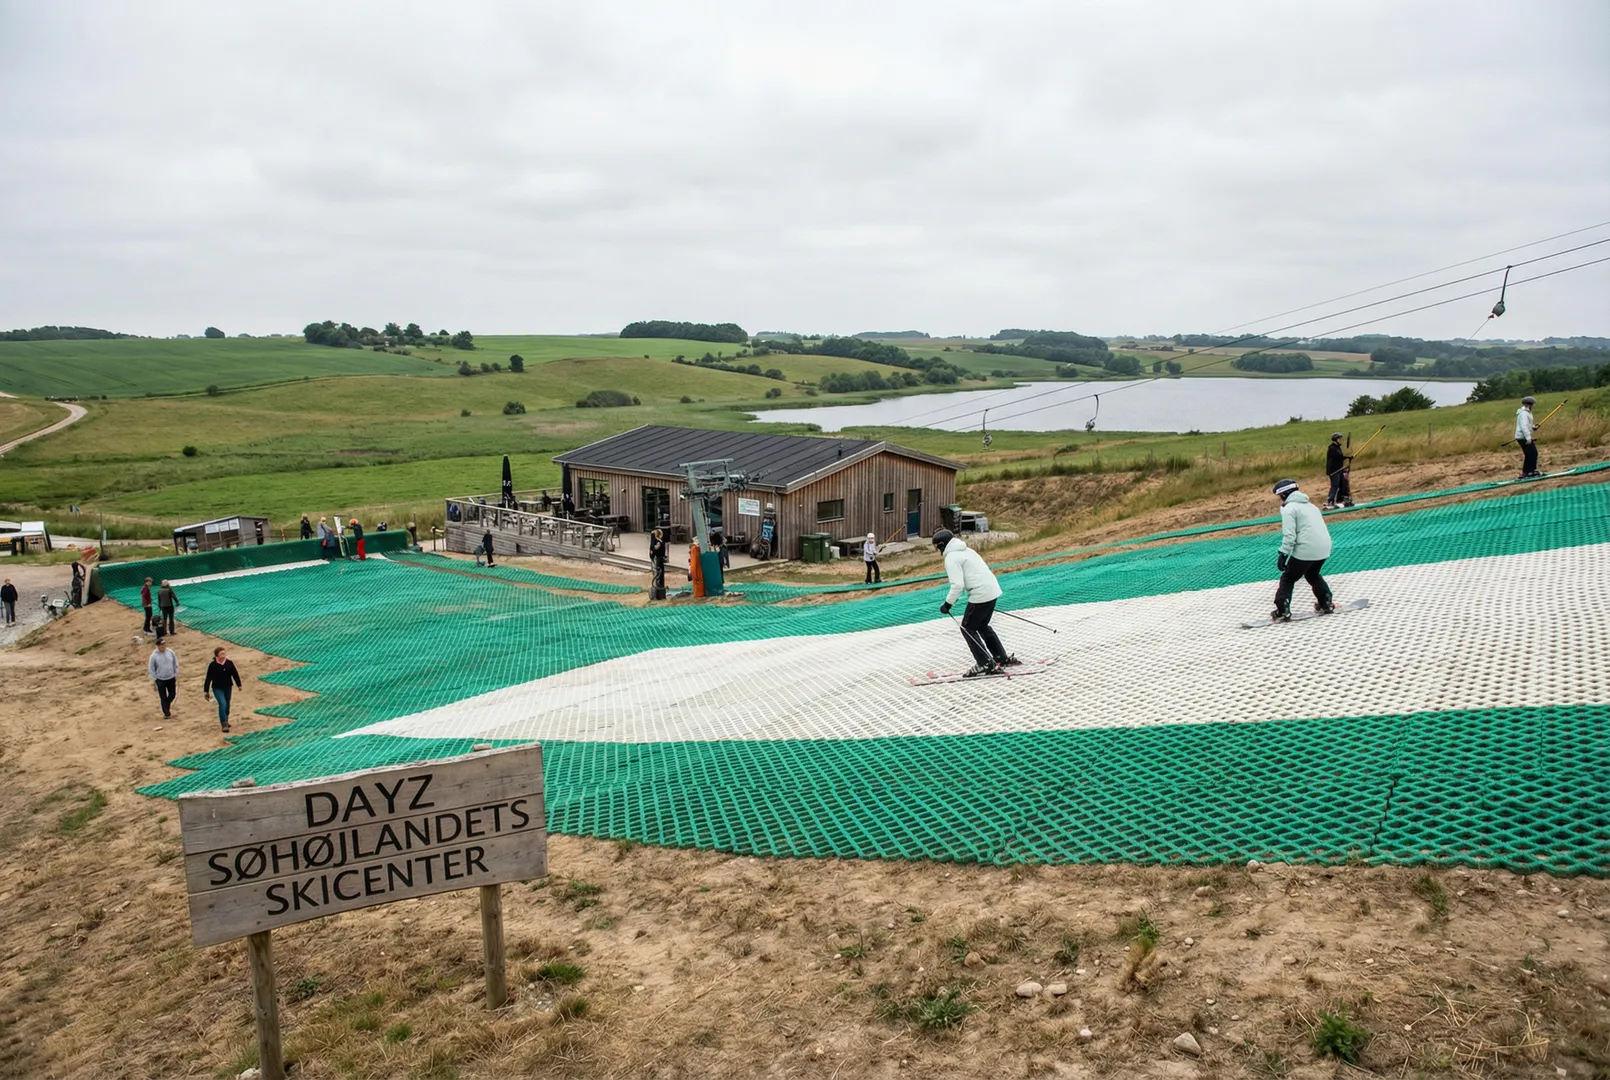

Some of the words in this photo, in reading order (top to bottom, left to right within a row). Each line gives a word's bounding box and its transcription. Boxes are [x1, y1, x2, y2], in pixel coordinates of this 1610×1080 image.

[304, 774, 435, 828] DAYZ
[208, 799, 530, 886] SØHØJLANDETS
[266, 846, 490, 916] SKICENTER
